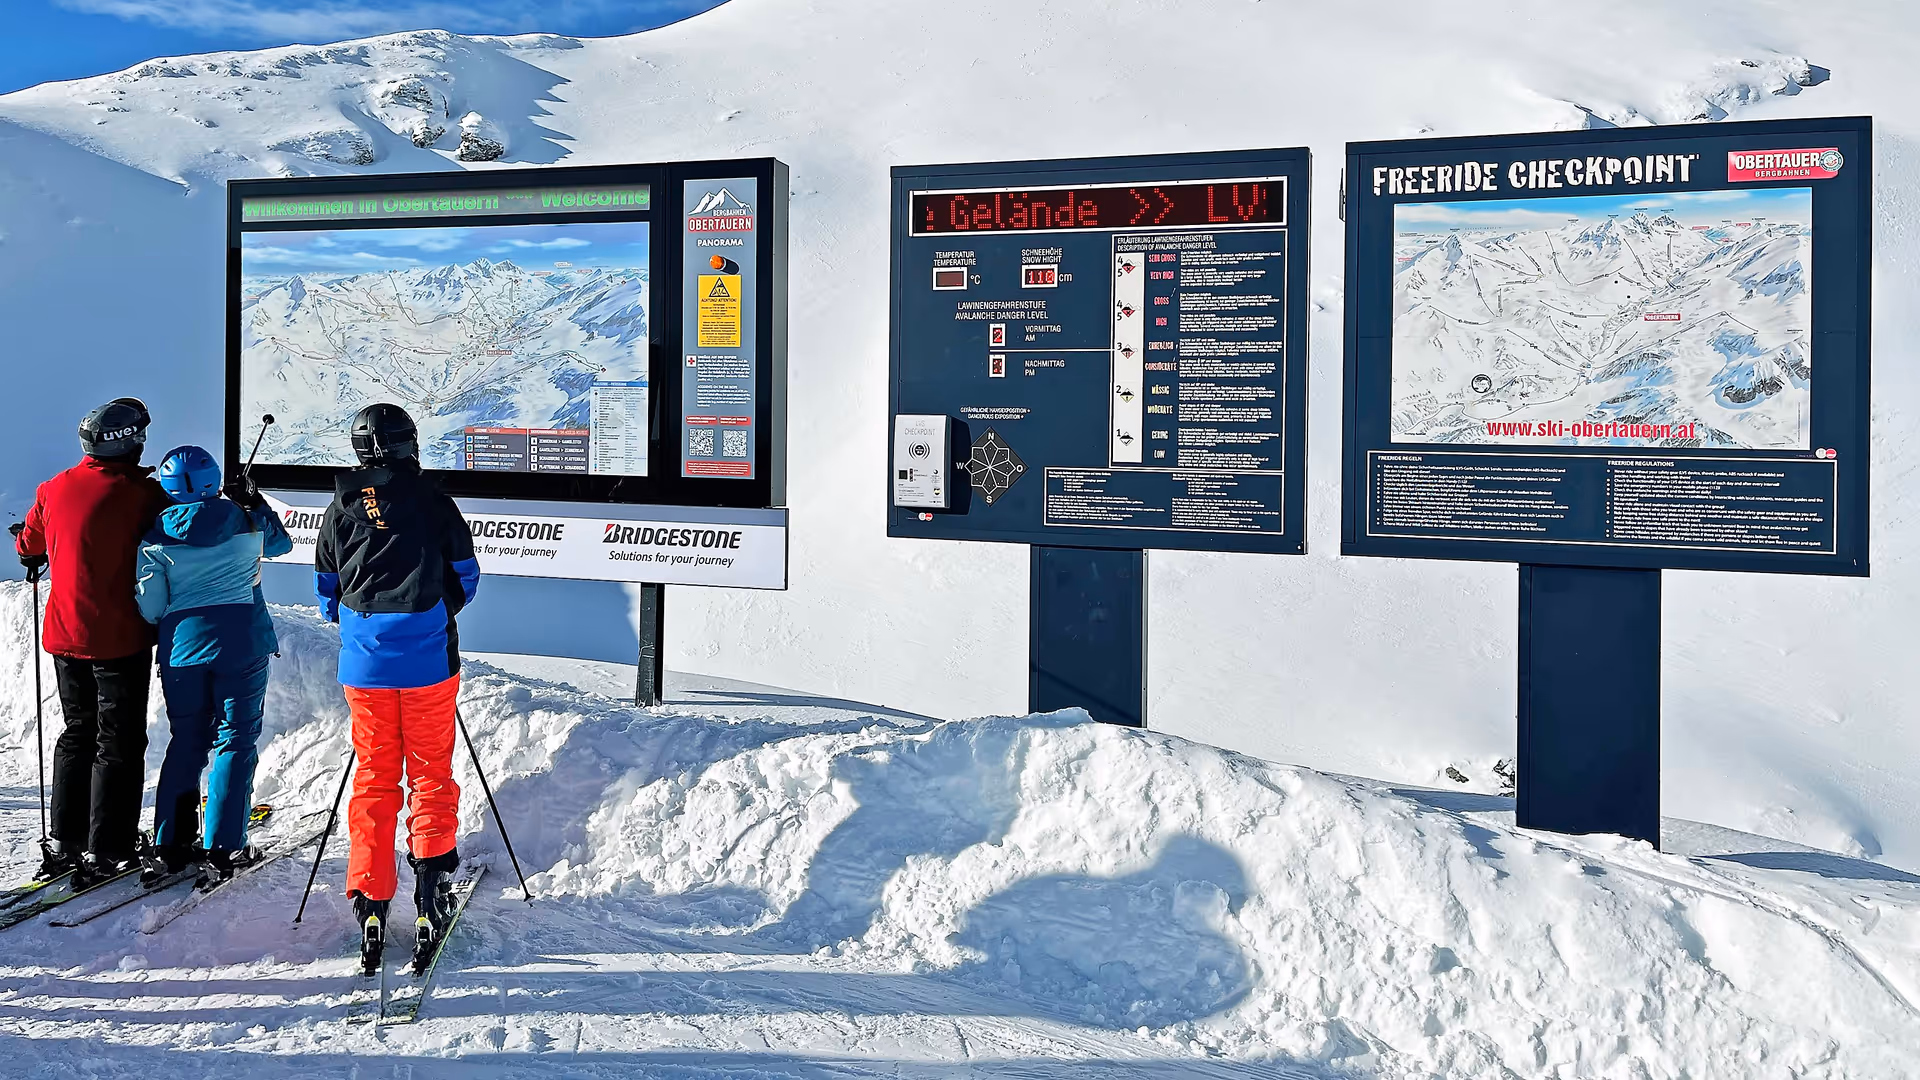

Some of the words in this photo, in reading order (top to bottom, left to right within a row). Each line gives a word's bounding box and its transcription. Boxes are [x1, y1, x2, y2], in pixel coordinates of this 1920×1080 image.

[1735, 152, 1822, 170] OBERTAUER
[1373, 162, 1498, 196] FREERIDE
[1508, 154, 1696, 190] CHECKPOINT
[1755, 169, 1810, 178] BERGBAHNEN
[244, 199, 353, 217] Willkommen
[359, 198, 377, 214] in
[383, 194, 499, 212] Obertauern
[541, 189, 649, 208] Welcome
[712, 208, 746, 216] BERGBAHNEN
[951, 191, 1098, 230] Gelände
[689, 218, 752, 231] OBERTAUERN
[697, 238, 744, 247] PANORAMA
[935, 250, 975, 259] TEMPERATUR
[1021, 246, 1063, 256] SCHNEEHÖHE
[933, 258, 977, 266] TEMPERATURE
[1022, 256, 1042, 264] SNOW
[1117, 256, 1124, 264] 4
[1058, 272, 1073, 282] cm
[1117, 268, 1123, 278] 5
[957, 300, 1046, 310] LAWINENGEFAHRENSTUFE
[1116, 300, 1122, 308] 4
[954, 312, 996, 320] AVALANCHE
[996, 312, 1026, 320] DANGER
[1027, 311, 1049, 320] LEVEL
[1116, 312, 1122, 321] 5
[1024, 325, 1062, 333] VORMITTAG
[994, 328, 1003, 342] 2
[1116, 342, 1122, 350] 3
[1116, 385, 1122, 394] 2
[904, 428, 936, 436] CHECKPOINT
[1116, 428, 1121, 437] 1
[1487, 420, 1696, 439] www.ski-obertauern.at
[987, 432, 994, 440] N
[956, 462, 965, 470] W
[1016, 464, 1024, 473] O
[986, 496, 993, 504] S
[467, 520, 564, 541] DGESTONE
[290, 535, 316, 545] olutio
[602, 523, 742, 549] BRIDGESTONE
[484, 544, 498, 554] for
[498, 547, 520, 557] your
[520, 546, 558, 560] journey
[608, 550, 653, 562] Solutions
[654, 552, 670, 563] for
[670, 556, 694, 566] your
[694, 554, 734, 568] journey
